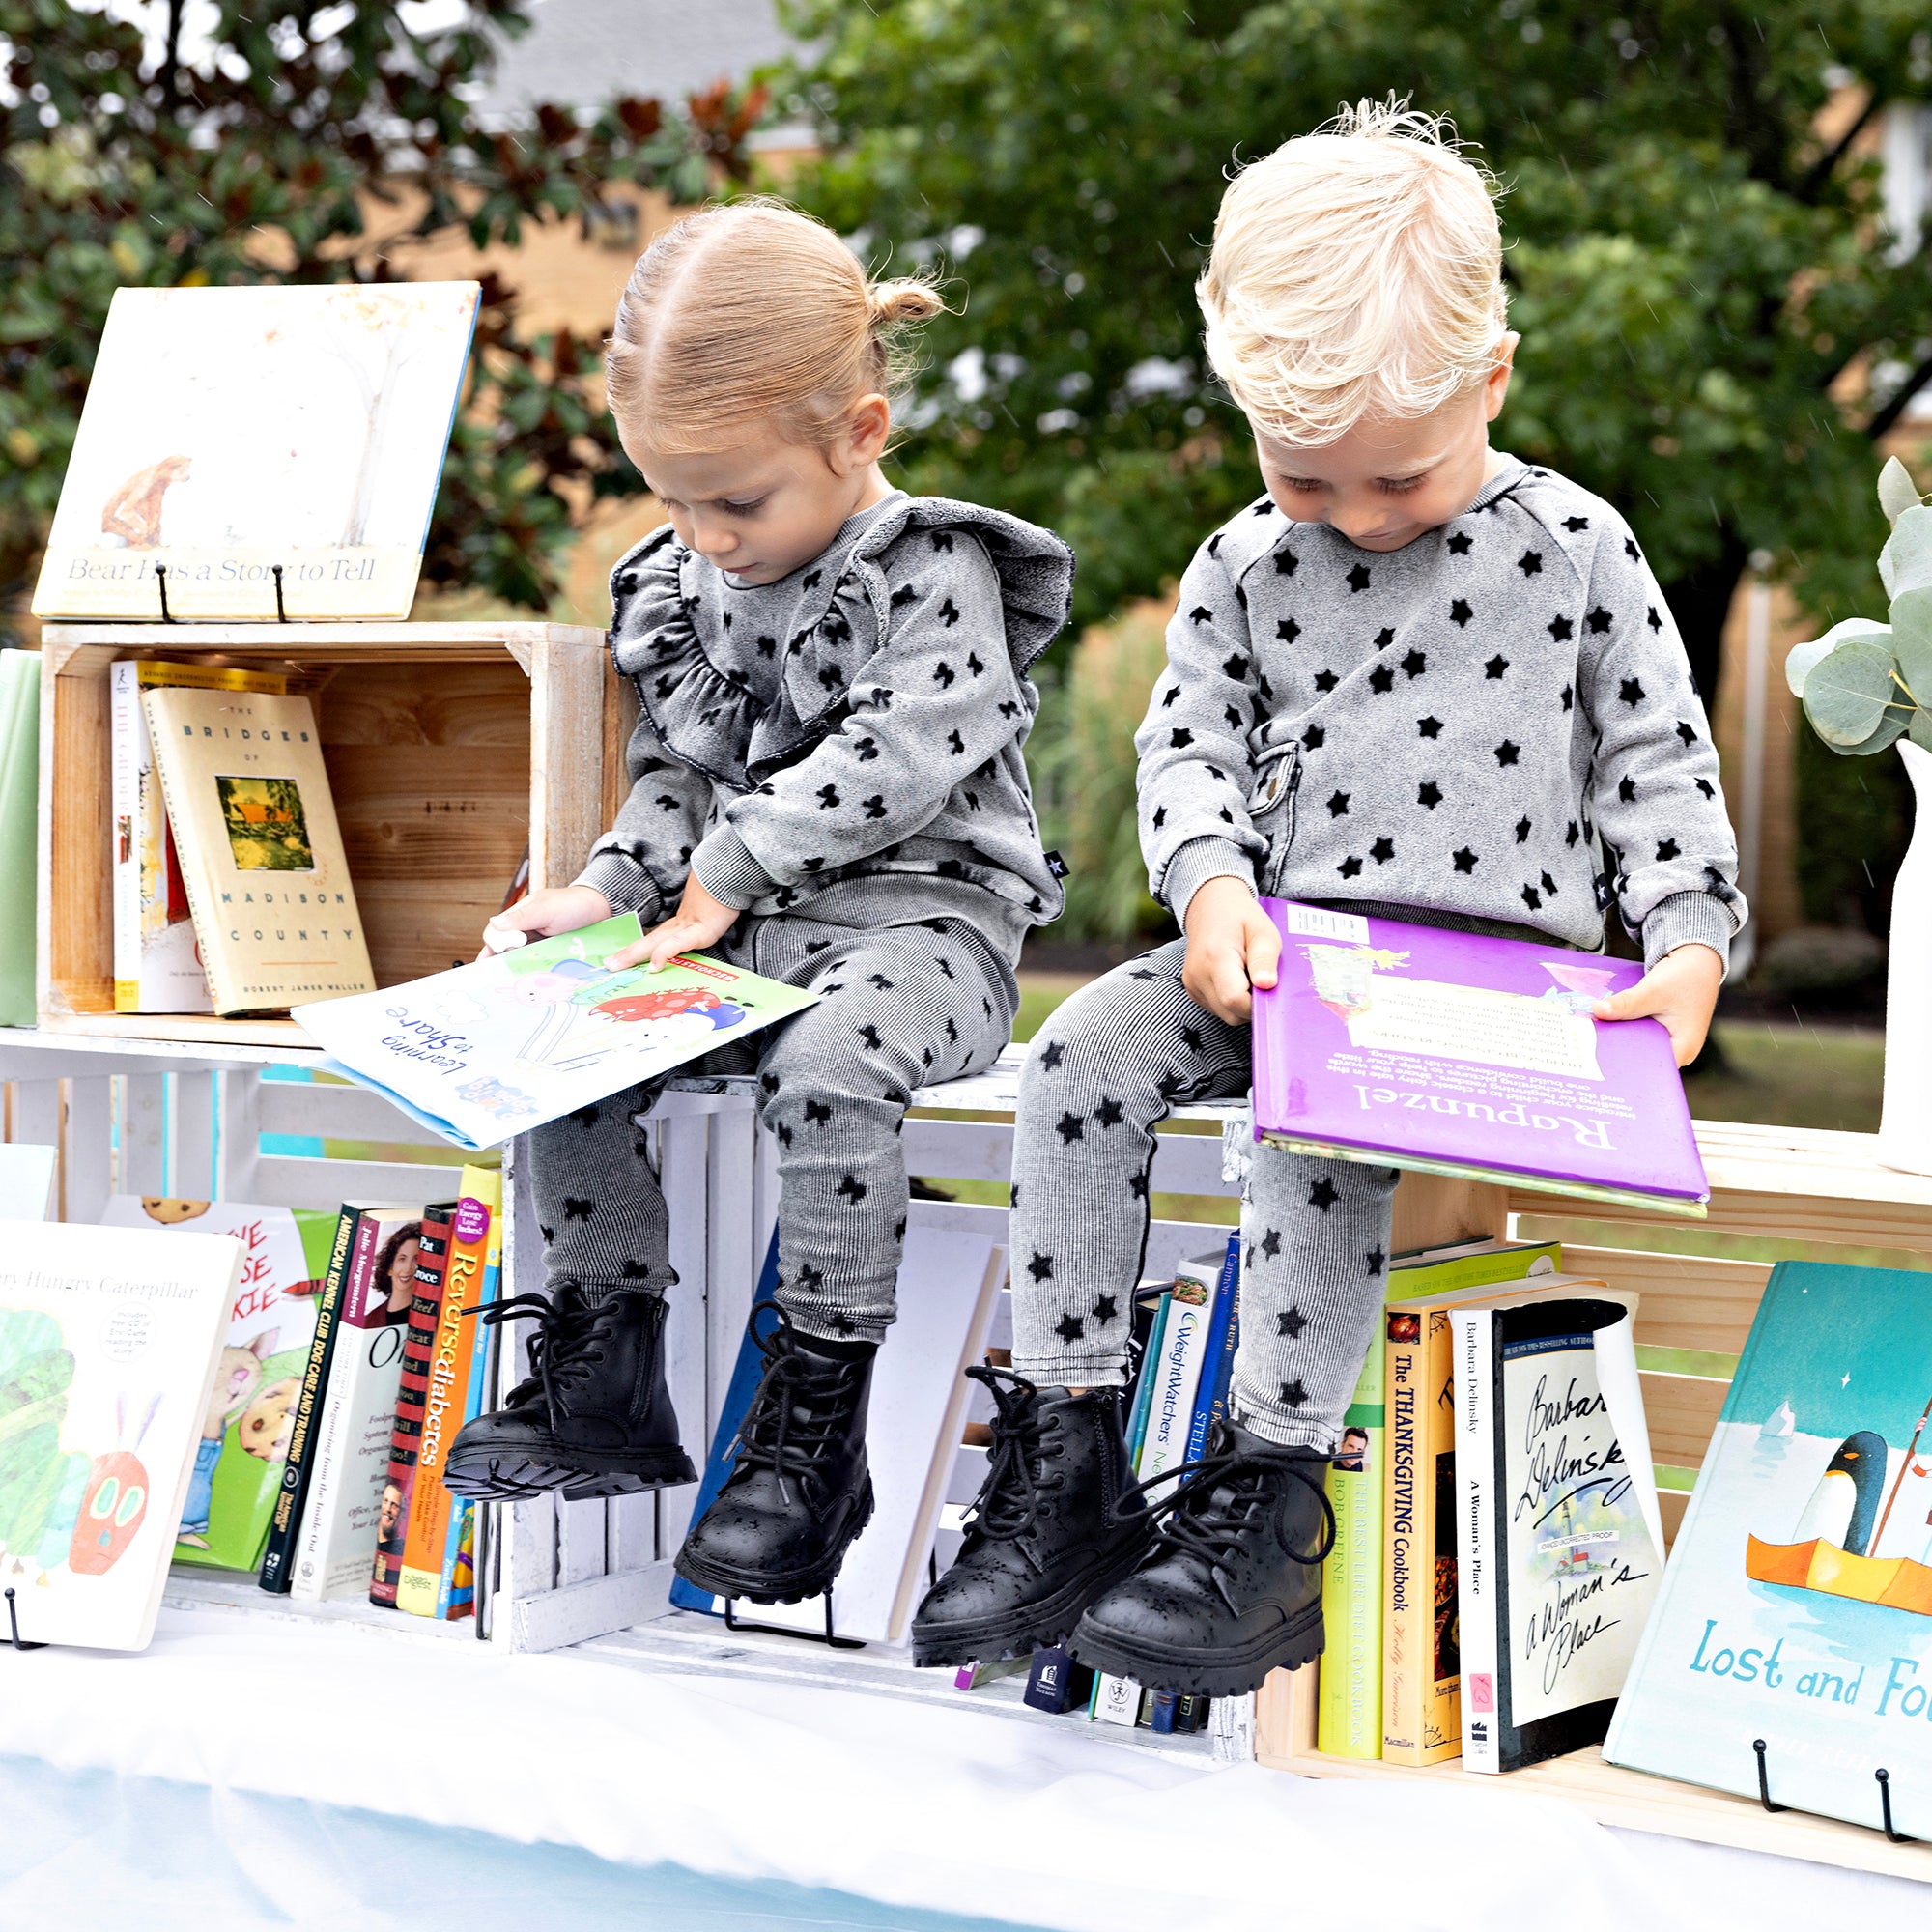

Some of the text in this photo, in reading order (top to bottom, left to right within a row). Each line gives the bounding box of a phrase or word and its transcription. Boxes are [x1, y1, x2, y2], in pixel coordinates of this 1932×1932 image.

[70, 558, 132, 580] Bear
[195, 564, 211, 581] a
[299, 561, 324, 581] to
[330, 558, 376, 581] Tell
[229, 706, 253, 715] THE
[184, 724, 310, 743] BRIDGES
[221, 893, 345, 905] MADISON
[230, 929, 354, 942] COUNTY
[385, 1006, 474, 1055] to Share
[381, 1035, 468, 1076] Learning
[1327, 1057, 1367, 1069] words
[1333, 1051, 1362, 1062] little
[1365, 1056, 1394, 1065] your
[1423, 1059, 1452, 1069] with
[1325, 1064, 1349, 1073] this
[1370, 1070, 1393, 1080] tale
[1371, 1064, 1391, 1072] the
[1399, 1061, 1427, 1072] help
[1445, 1067, 1496, 1083] pictures
[1456, 1064, 1525, 1081] confidence
[1397, 1073, 1427, 1086] fairy
[1430, 1080, 1474, 1093] classic
[1499, 1077, 1573, 1095] enchanting
[1529, 1075, 1562, 1087] build
[1566, 1081, 1590, 1091] one
[1489, 1082, 1555, 1099] beginning
[1506, 1093, 1538, 1103] child
[1599, 1094, 1625, 1103] and
[1542, 1097, 1572, 1107] your
[1579, 1096, 1632, 1111] retelling
[1353, 1084, 1619, 1151] Rapunzel
[1575, 1103, 1635, 1120] Introduce
[459, 1208, 483, 1221] Energy
[462, 1217, 478, 1227] Lose
[419, 1236, 435, 1253] Pat
[346, 1225, 374, 1318] Julie Morgenstern
[1220, 1253, 1237, 1295] Cannon
[26, 1270, 94, 1296] Hungry
[99, 1275, 201, 1301] Caterpillar
[412, 1298, 435, 1315] Feel
[286, 1214, 354, 1463] AMERICAN KENNEL CLUB DOG CARE AND TRAINING
[408, 1330, 430, 1345] reat
[1225, 1324, 1236, 1351] RUTH
[418, 1249, 480, 1467] Reverse diabetes
[1158, 1325, 1192, 1446] WeightWatchers
[1466, 1321, 1478, 1435] Barbara Delinsky
[1526, 1373, 1607, 1455] Barbar
[1186, 1410, 1208, 1464] STELLA
[306, 1401, 342, 1553] Organizing from the Inside Out
[1393, 1354, 1416, 1612] The THANKSGIVING Cookbook
[1331, 1478, 1346, 1585] BOB GREENE
[1470, 1480, 1482, 1596] A Woman's Place
[1542, 1557, 1649, 1642] Woman's
[1346, 1478, 1368, 1747] THE BEST LIFE DIET COOKBOOK
[1543, 1614, 1621, 1695] Place
[1689, 1619, 1786, 1689] Lost
[1796, 1665, 1865, 1705] and
[1388, 1623, 1406, 1727] Holly Garrison
[1107, 1703, 1127, 1715] WILEY
